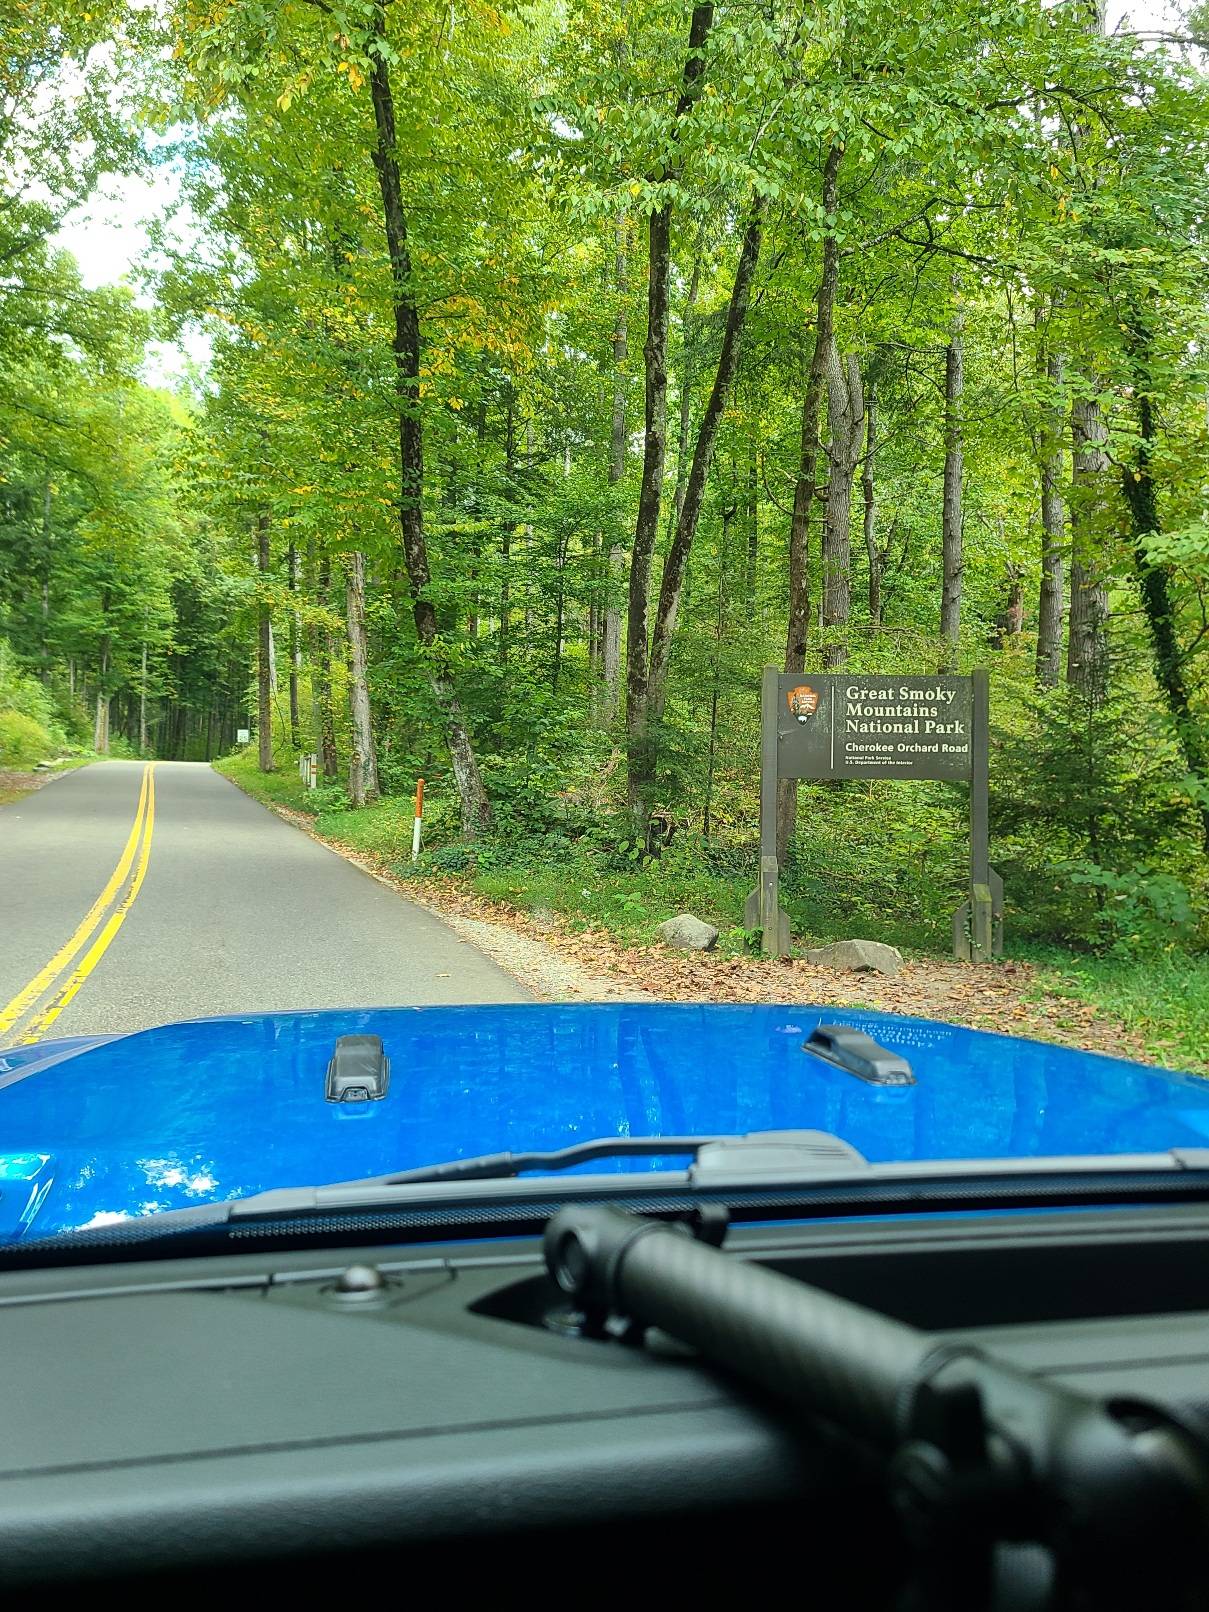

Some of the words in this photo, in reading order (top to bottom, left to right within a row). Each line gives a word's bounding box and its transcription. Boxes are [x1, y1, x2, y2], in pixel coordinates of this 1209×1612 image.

[846, 686, 894, 700] Great
[900, 686, 956, 704] Smoky
[846, 703, 938, 717] Mountains
[846, 720, 919, 734] National
[925, 720, 965, 734] Park
[845, 742, 894, 752] Cherokee
[898, 743, 938, 752] Orchard
[942, 743, 968, 753] Road
